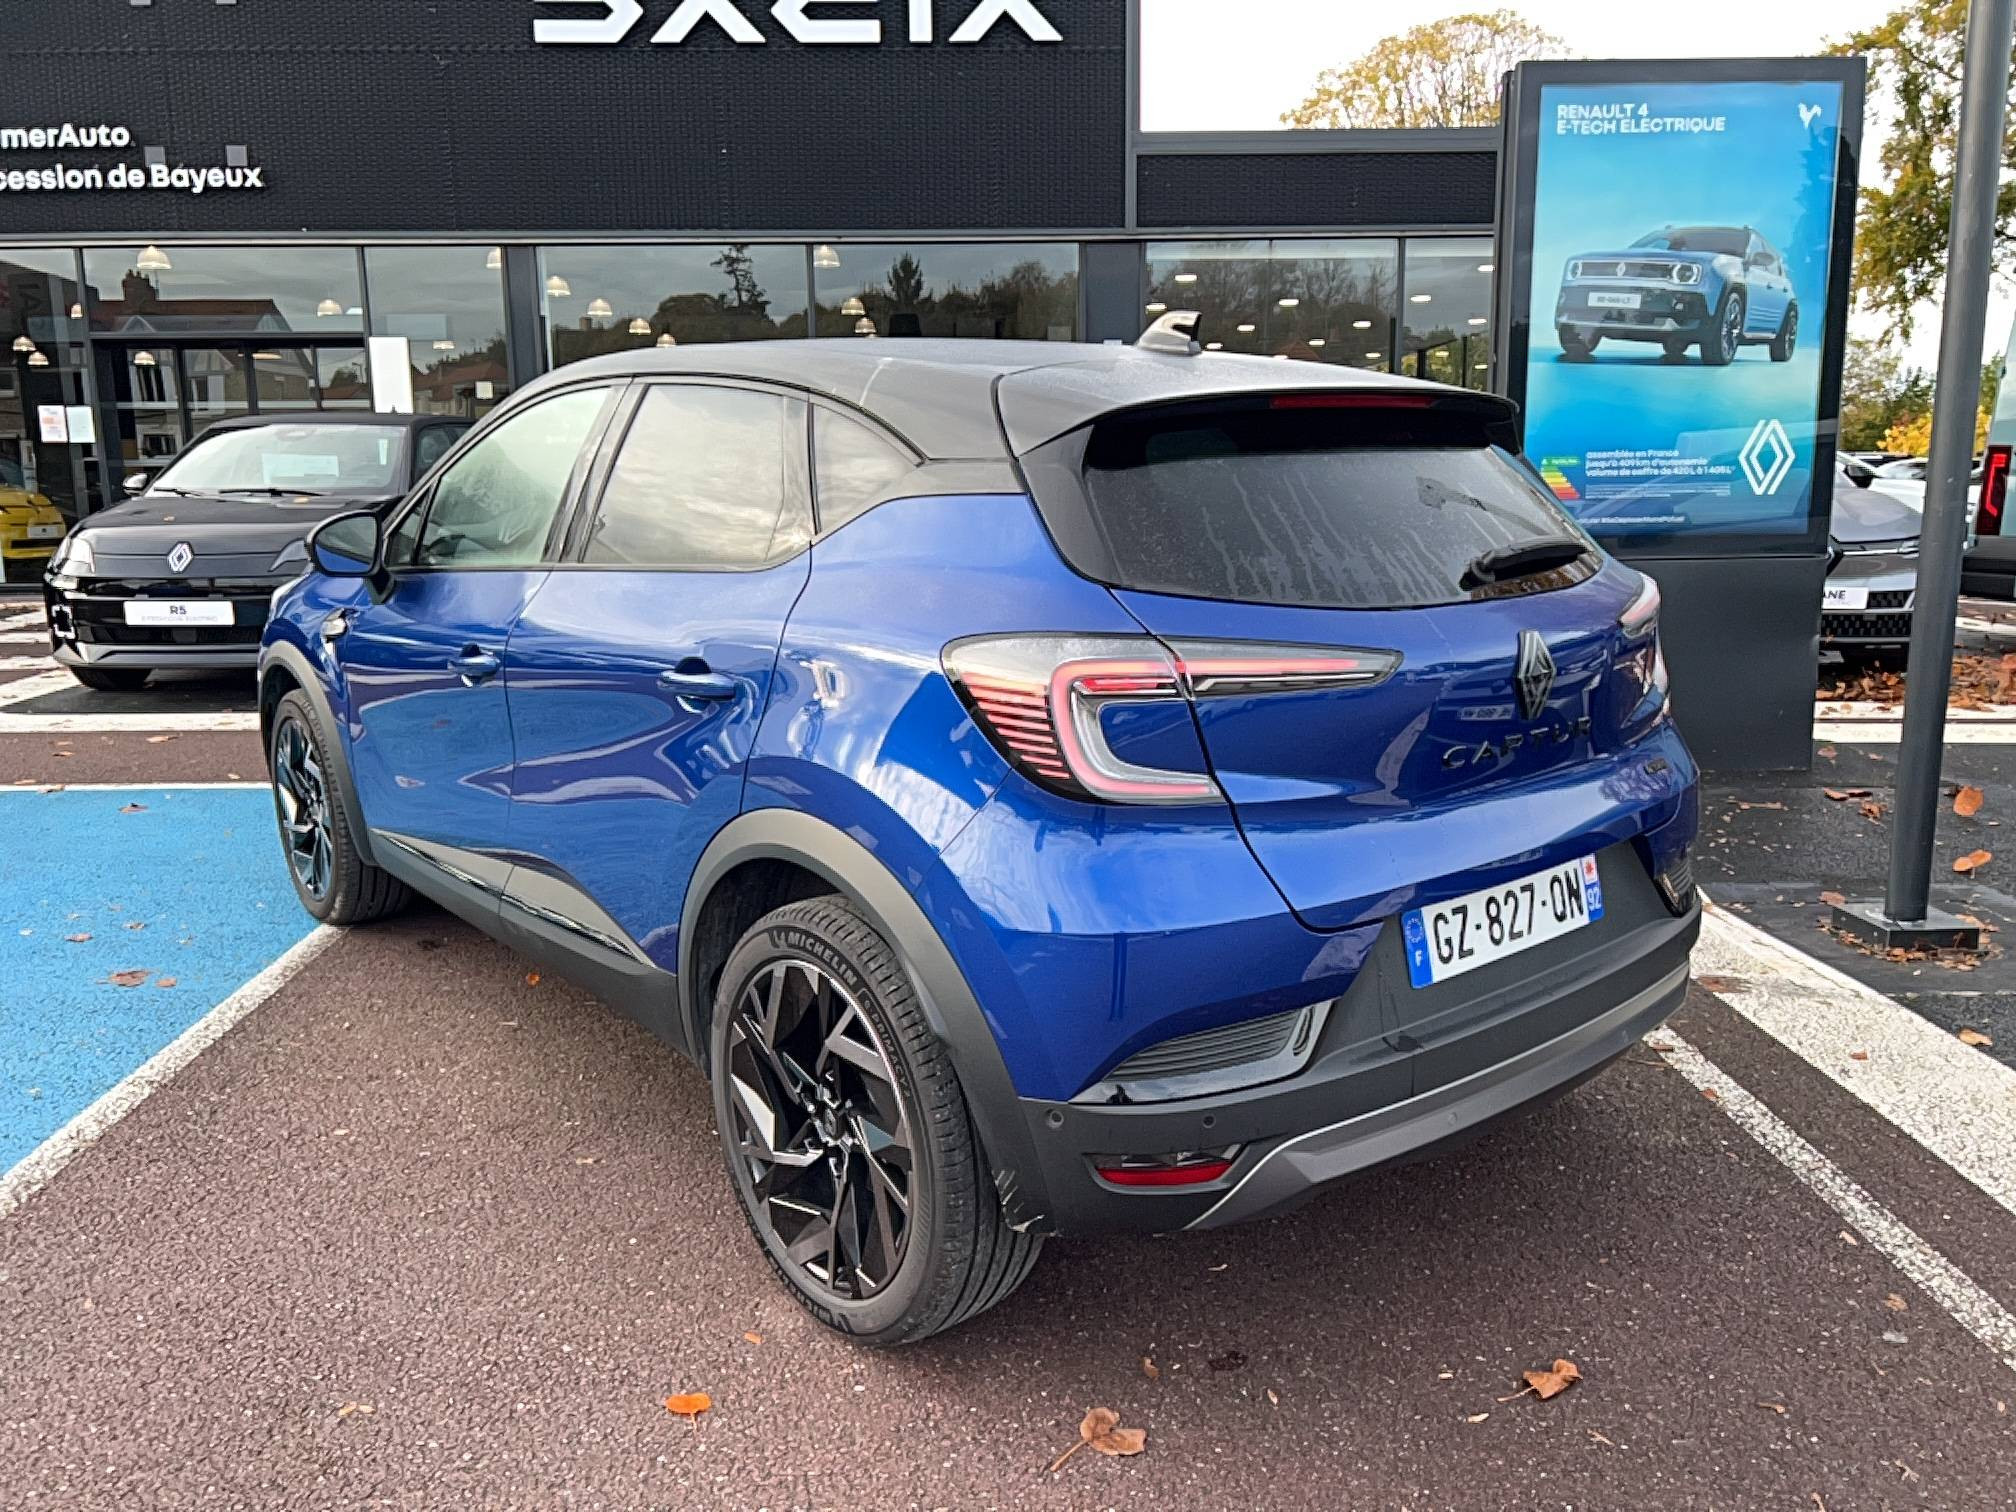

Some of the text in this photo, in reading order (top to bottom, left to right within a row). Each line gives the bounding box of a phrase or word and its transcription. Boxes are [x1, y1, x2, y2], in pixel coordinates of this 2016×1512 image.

[1557, 102, 1649, 119] RENAULT 4
[0, 122, 131, 149] merAuto
[1556, 119, 1616, 135] E-TECH
[107, 163, 146, 189] de
[150, 164, 264, 194] Bayeux
[169, 605, 187, 615] R5
[1442, 715, 1592, 769] CAPTUR
[1587, 886, 1602, 912] 92
[787, 930, 858, 987] MICHELIN
[1414, 949, 1424, 968] F
